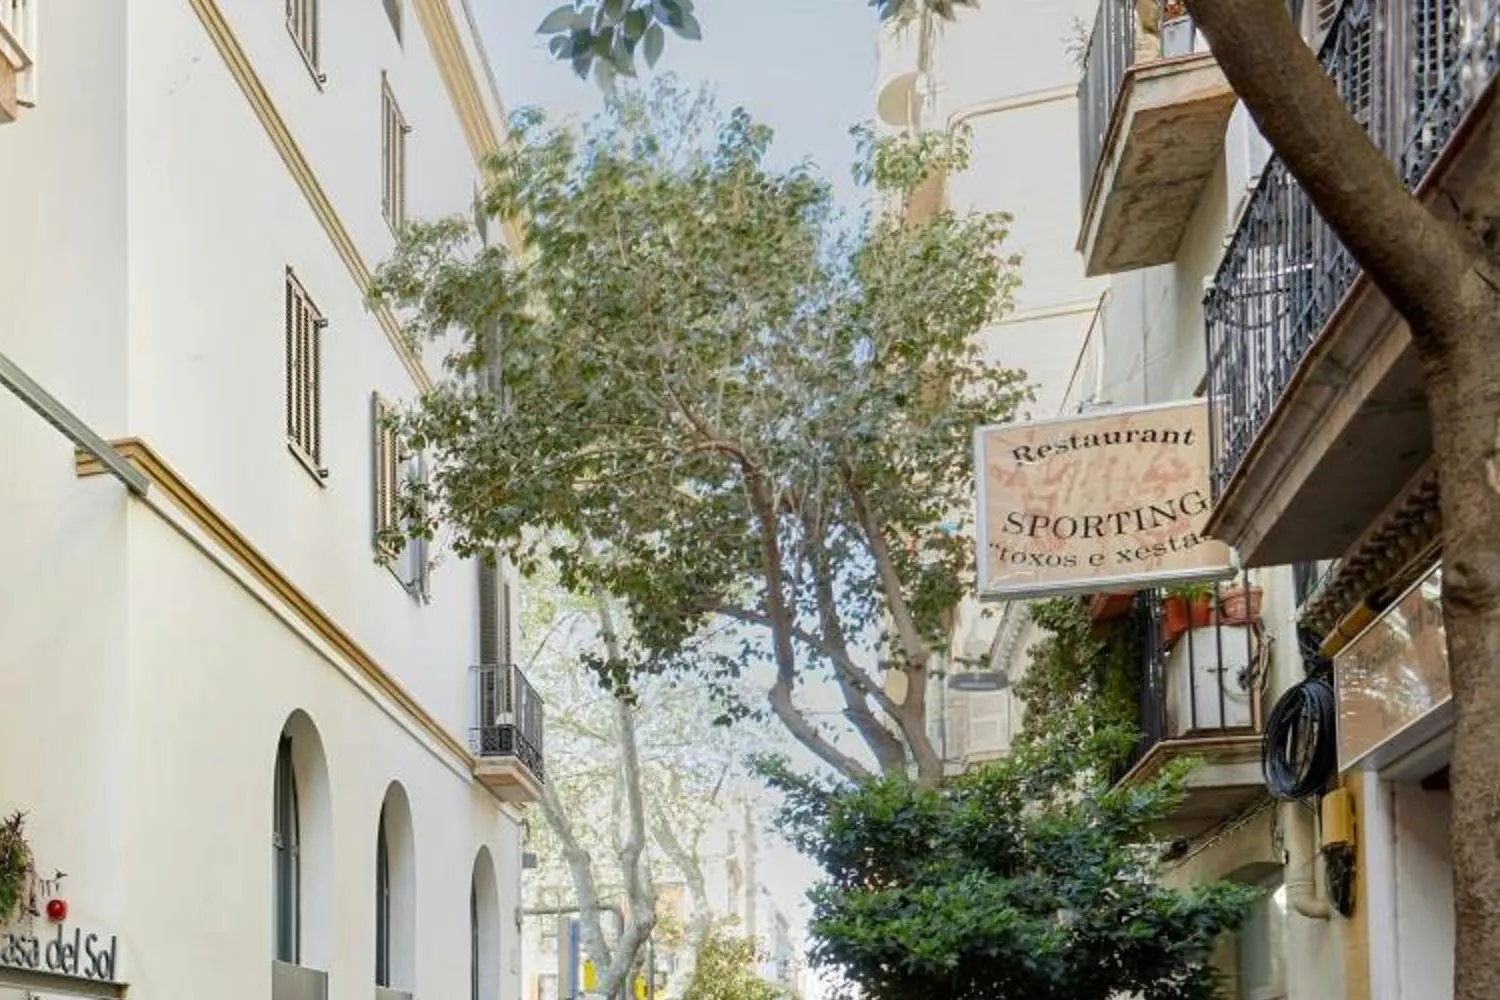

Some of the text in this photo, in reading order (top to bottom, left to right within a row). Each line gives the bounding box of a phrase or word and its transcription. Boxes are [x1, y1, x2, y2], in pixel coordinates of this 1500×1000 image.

[1012, 427, 1195, 465] Restaurant
[1003, 489, 1209, 538] SPORTING
[1089, 553, 1105, 567] e
[46, 923, 80, 974] del
[85, 933, 116, 980] Sol
